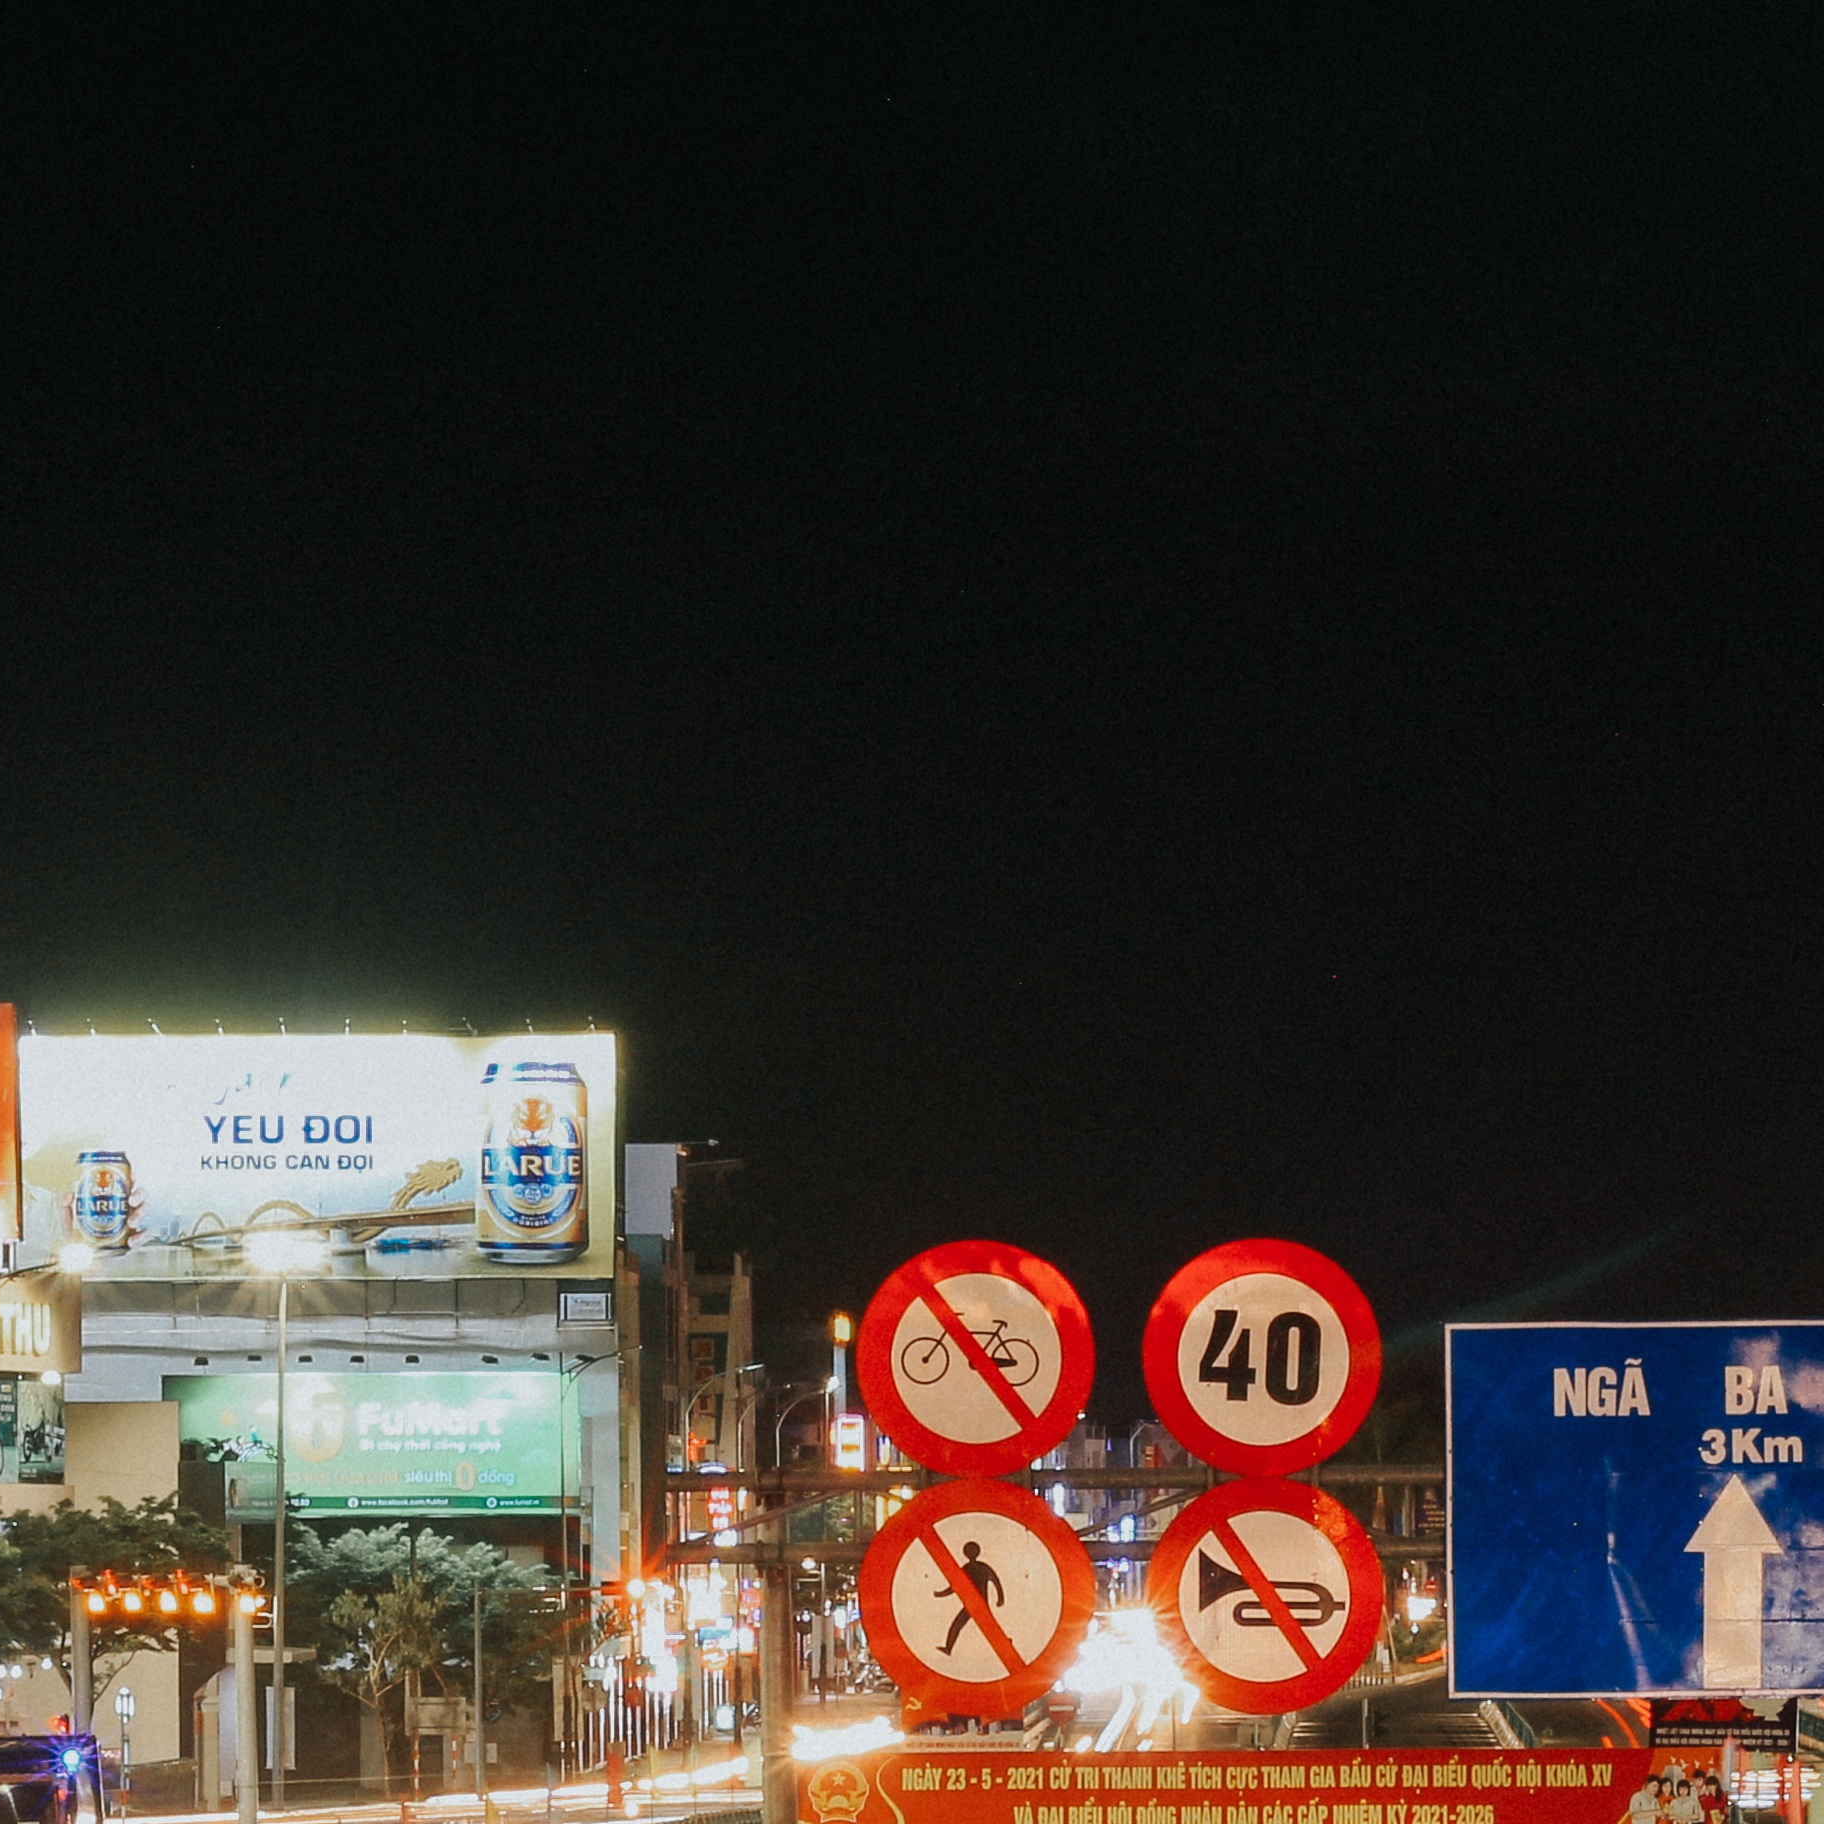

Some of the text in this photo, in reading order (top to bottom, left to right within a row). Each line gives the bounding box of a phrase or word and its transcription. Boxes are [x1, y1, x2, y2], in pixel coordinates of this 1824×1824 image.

[484, 1155, 581, 1177] LARUE
[77, 1200, 129, 1213] LARUE
[1198, 1309, 1321, 1406] 40
[1553, 1357, 1651, 1418] NGÃ
[1724, 1365, 1787, 1416] BA
[1699, 1430, 1804, 1465] 3Km
[902, 1762, 942, 1790] NGÀY
[946, 1768, 966, 1790] 23
[981, 1768, 992, 1790] 5
[1007, 1767, 1044, 1790] 2021
[1076, 1767, 1098, 1789] TRI
[1102, 1766, 1152, 1789] THANH
[1156, 1761, 1186, 1789] KHÊ
[1189, 1761, 1222, 1789] TÍCH
[1226, 1766, 1258, 1796] CỰC
[1261, 1766, 1305, 1788] THAM
[1309, 1766, 1336, 1788] GIA
[1401, 1765, 1428, 1794] ĐẠI
[1471, 1756, 1512, 1790] QUỐC
[1516, 1759, 1542, 1794] HỘI
[1546, 1759, 1588, 1787] KHÓA
[1592, 1764, 1612, 1787] XV
